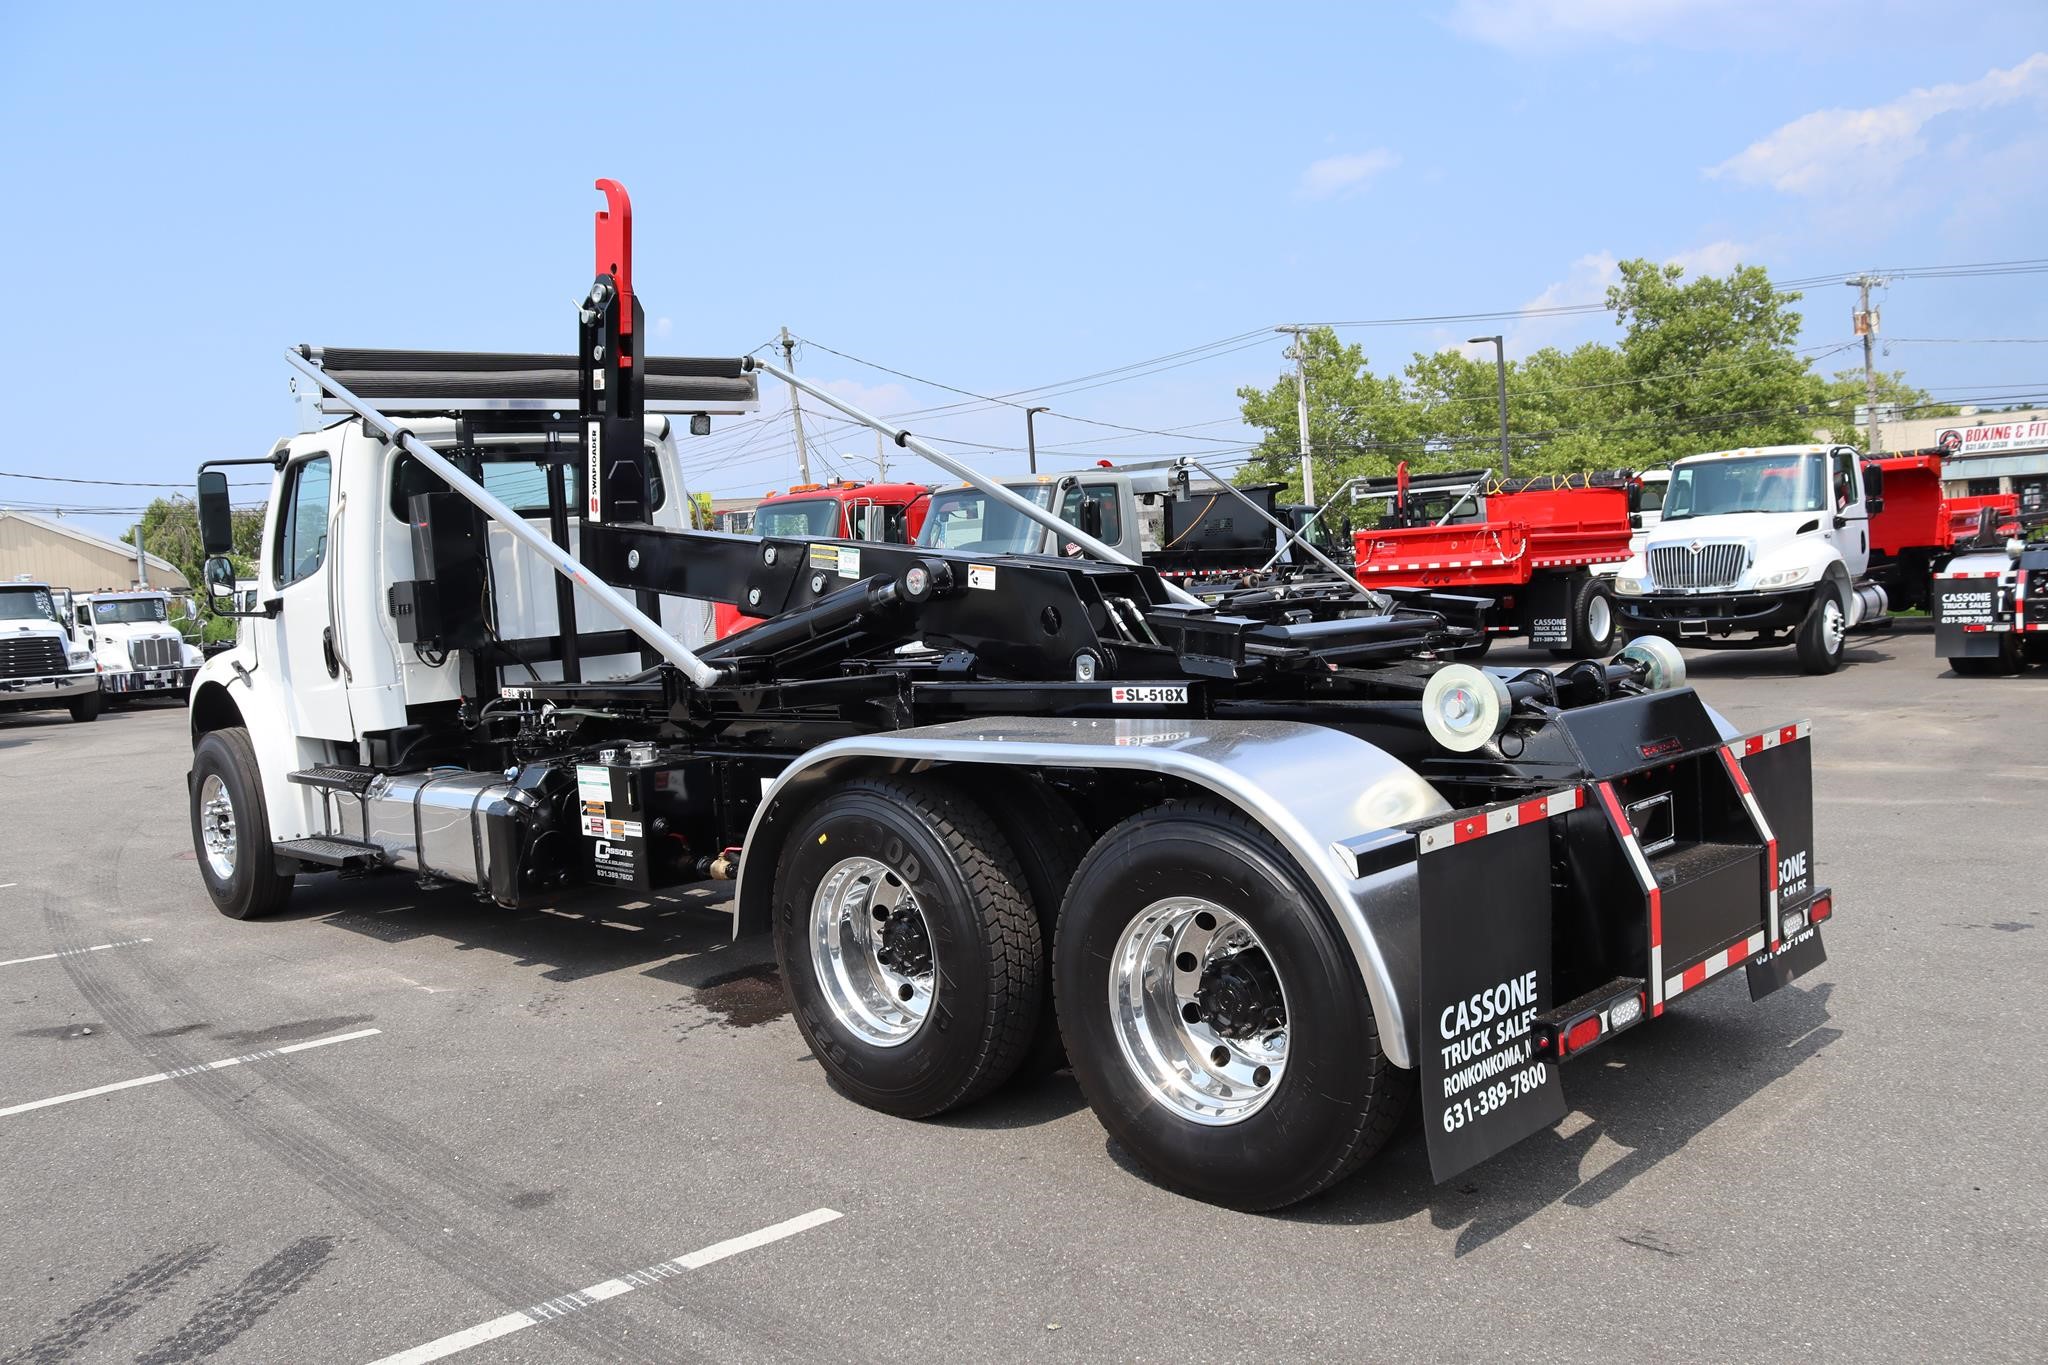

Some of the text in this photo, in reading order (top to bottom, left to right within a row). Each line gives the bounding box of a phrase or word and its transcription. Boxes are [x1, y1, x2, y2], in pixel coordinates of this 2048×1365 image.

[1965, 425, 2012, 442] BOXING
[2015, 424, 2024, 439] &
[1941, 592, 1991, 603] CASSONE
[1942, 601, 1992, 610] TRUCK SALES
[1533, 618, 1567, 626] CASSONE
[1126, 688, 1185, 702] SL-518X
[1440, 969, 1538, 1040] CASSONE
[1441, 1006, 1538, 1070] TRUCK SALES
[1443, 1038, 1532, 1098] RONKONKOMA, N
[1443, 1062, 1547, 1133] 631-389-7800
